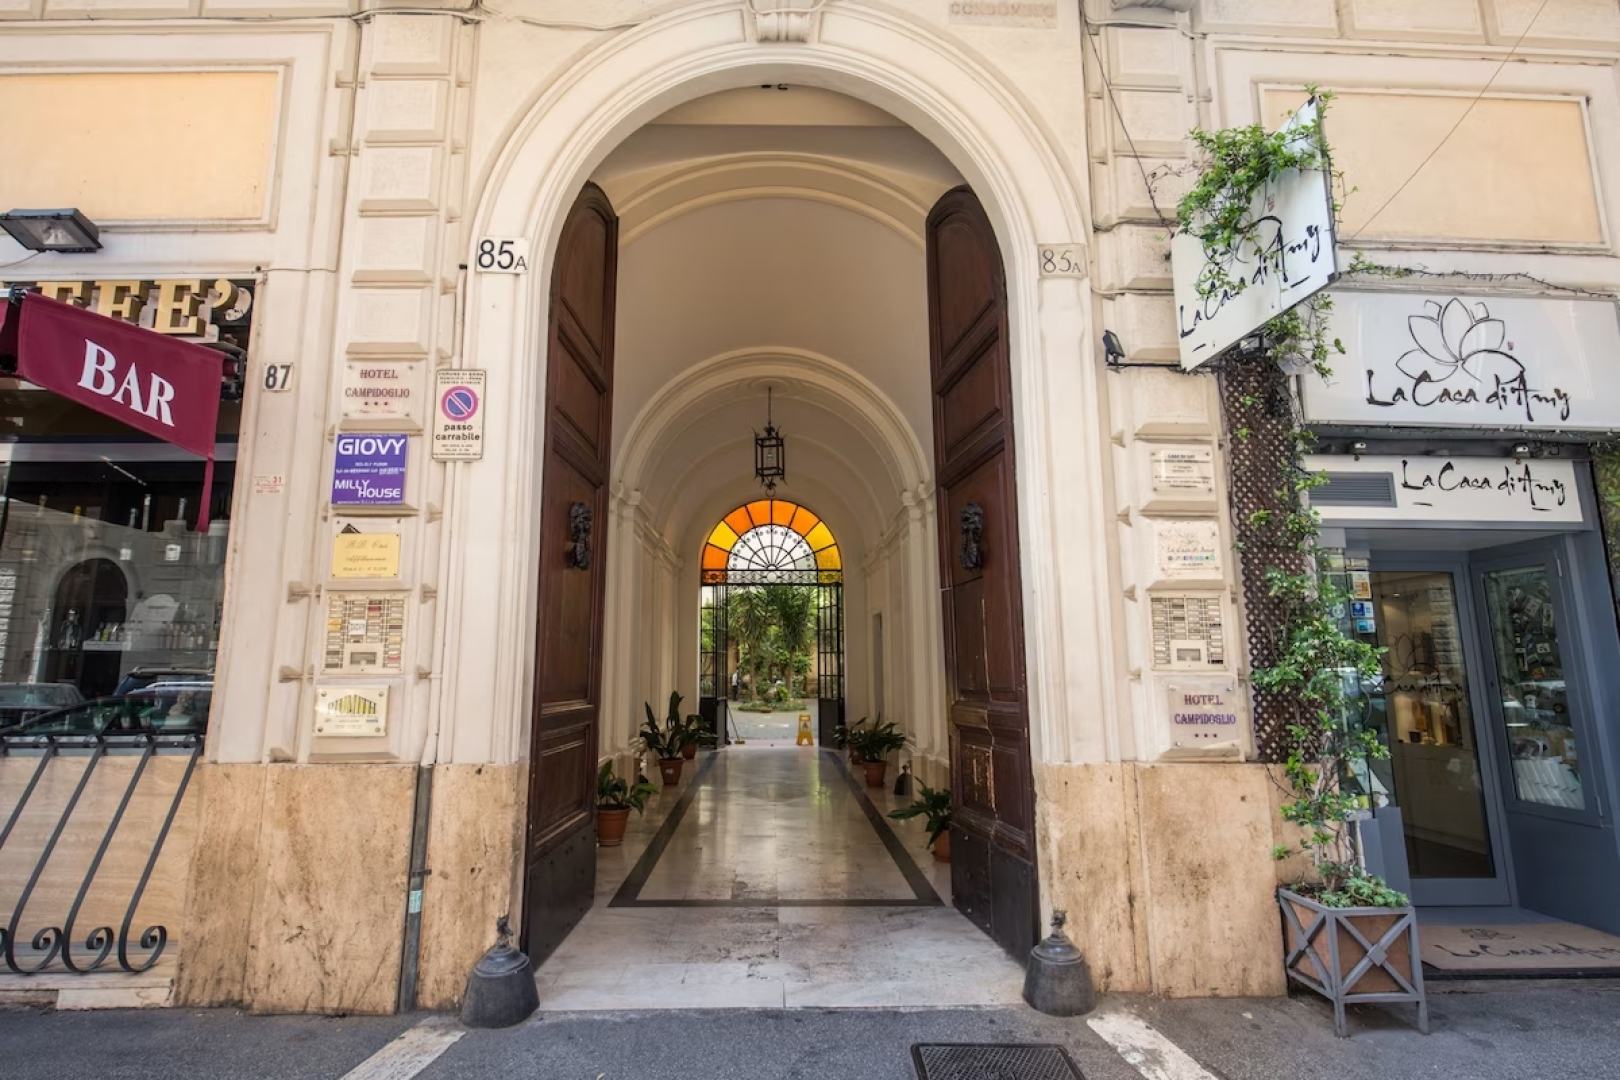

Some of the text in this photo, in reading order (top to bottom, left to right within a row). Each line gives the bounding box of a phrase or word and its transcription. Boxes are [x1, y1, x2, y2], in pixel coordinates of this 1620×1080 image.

[478, 239, 528, 270] 85A
[1042, 249, 1081, 273] 85A
[1179, 304, 1203, 339] La
[265, 364, 291, 389] 87
[359, 369, 399, 379] HOTEL
[77, 338, 176, 427] BAR
[345, 387, 410, 398] CAMPIDOGLIO
[1366, 368, 1570, 422] La Casa di Amy
[443, 424, 473, 432] passo
[435, 432, 480, 441] carrabile
[338, 438, 406, 456] GIOVY
[334, 479, 370, 492] MILLY
[1400, 459, 1567, 507] La Casa di Amy
[357, 487, 402, 498] HOUSE
[1184, 694, 1224, 706] HOTEL
[1174, 713, 1236, 725] CAMPIDOGLIO
